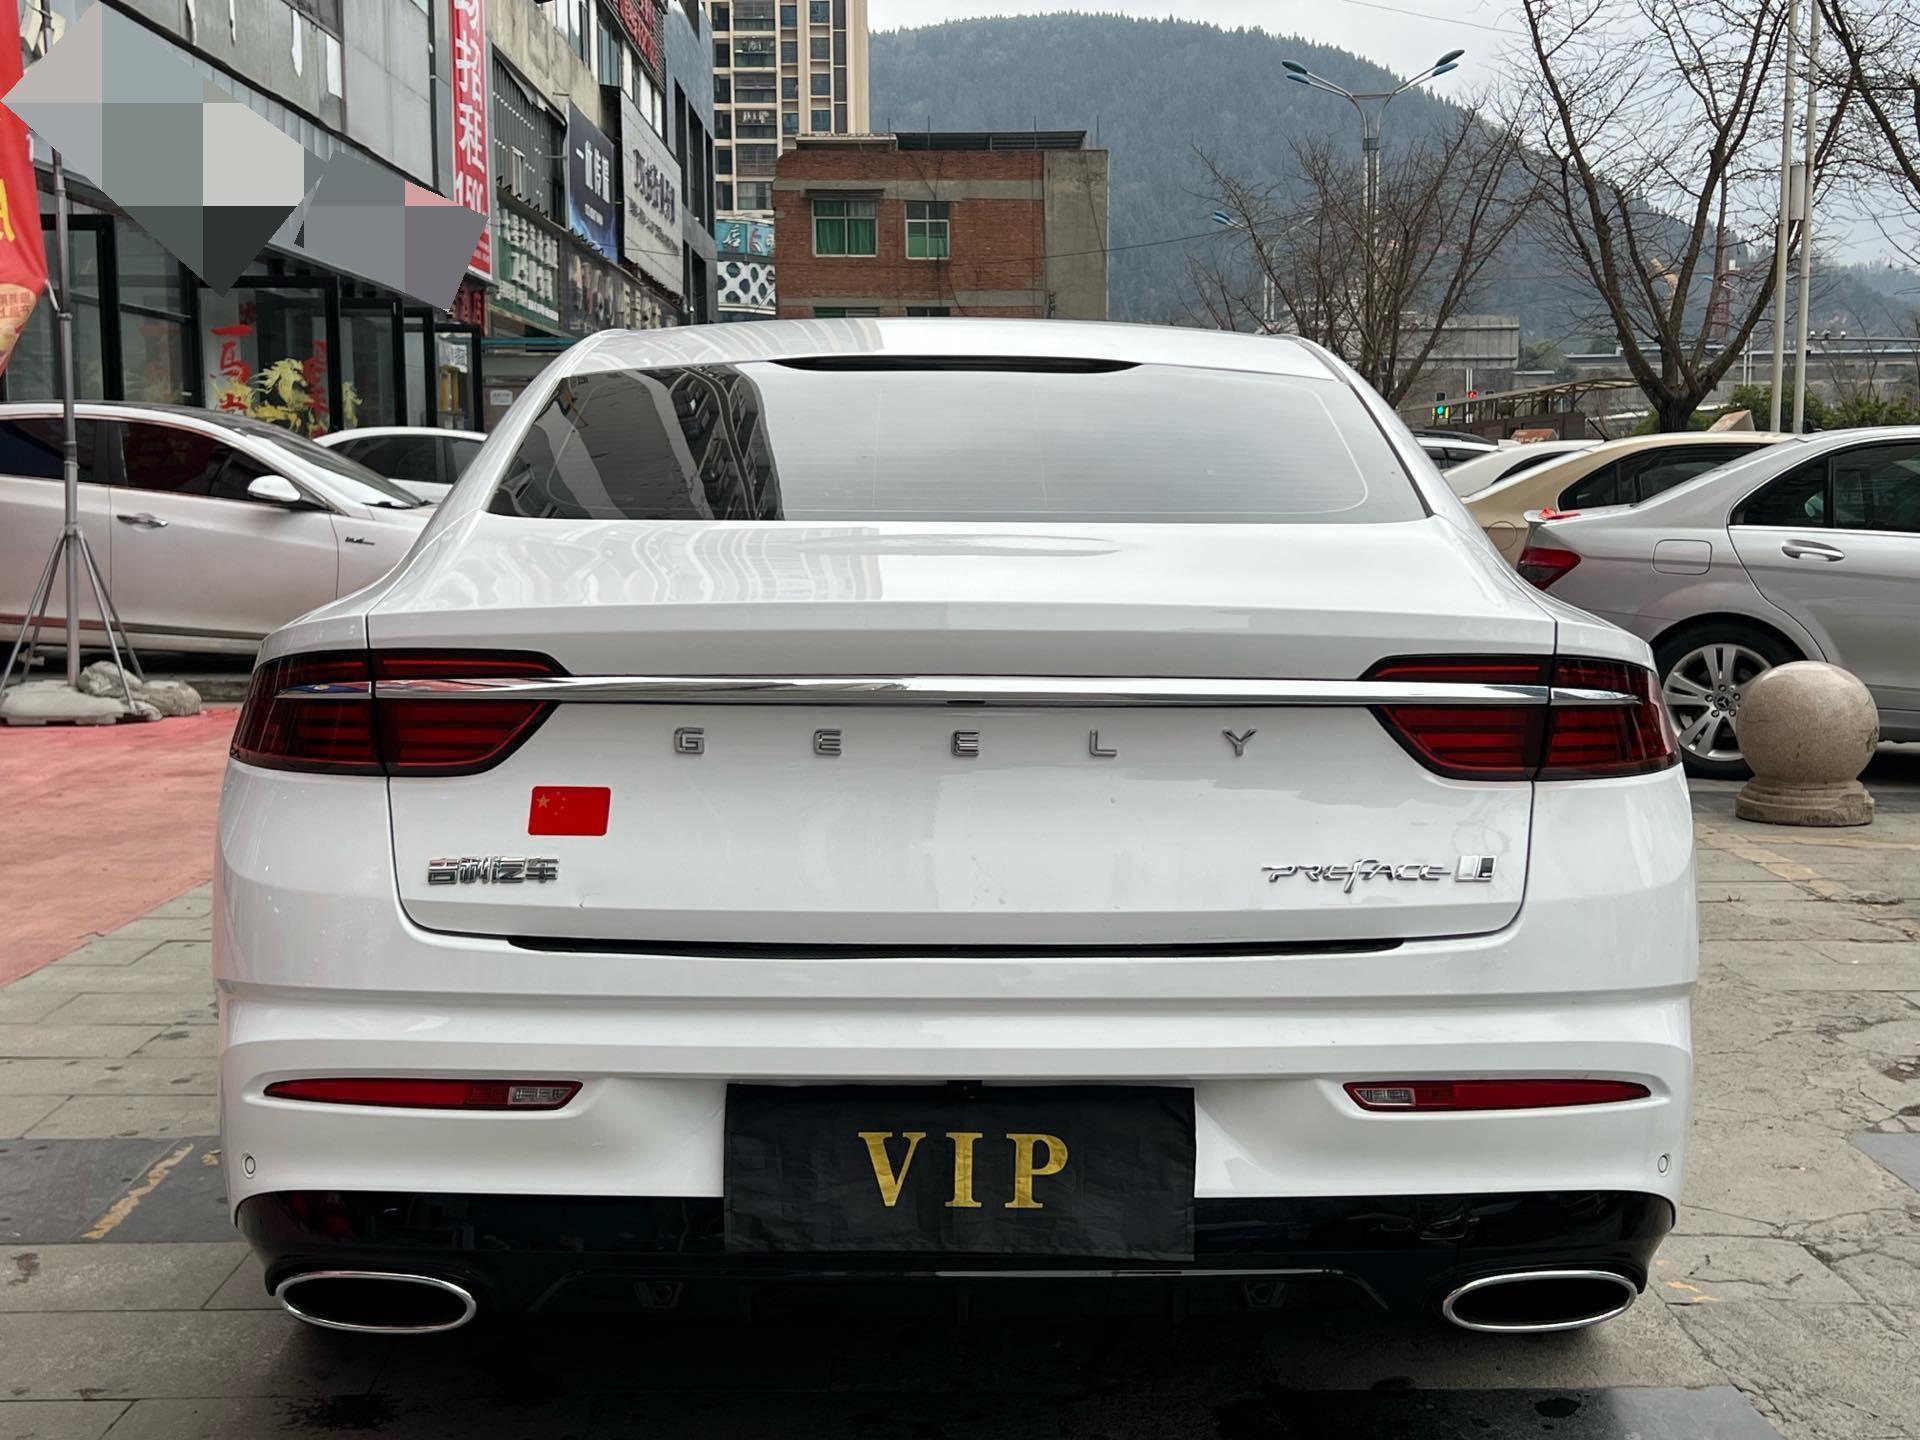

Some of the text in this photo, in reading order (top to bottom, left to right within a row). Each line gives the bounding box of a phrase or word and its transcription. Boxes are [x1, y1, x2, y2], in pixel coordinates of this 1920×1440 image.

[673, 727, 1257, 758] GEELY
[428, 856, 560, 884] 吉利汽车
[1261, 858, 1451, 894] PREFACE
[857, 1131, 1069, 1209] VIP
